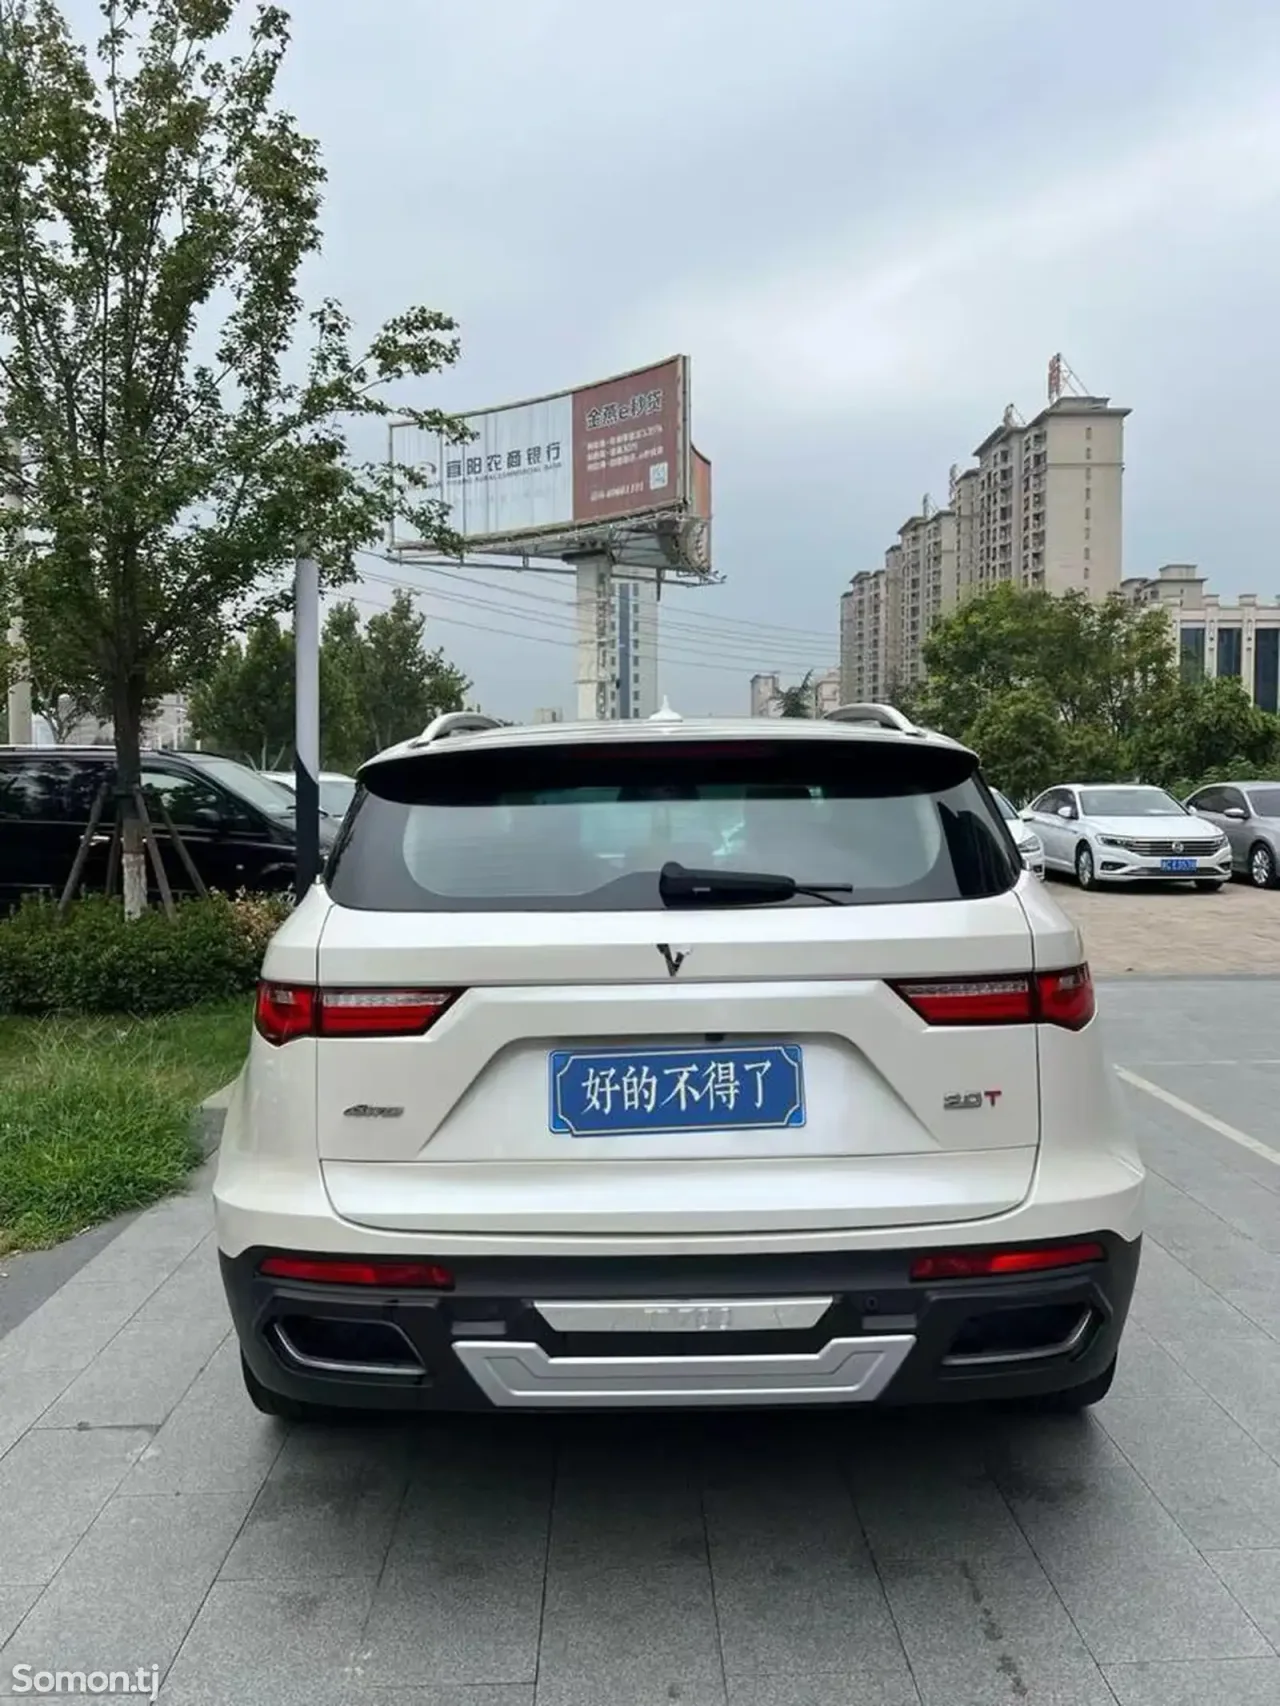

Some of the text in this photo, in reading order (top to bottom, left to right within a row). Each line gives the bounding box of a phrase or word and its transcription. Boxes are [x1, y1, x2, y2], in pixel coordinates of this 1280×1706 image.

[581, 1060, 772, 1115] 好的不得了
